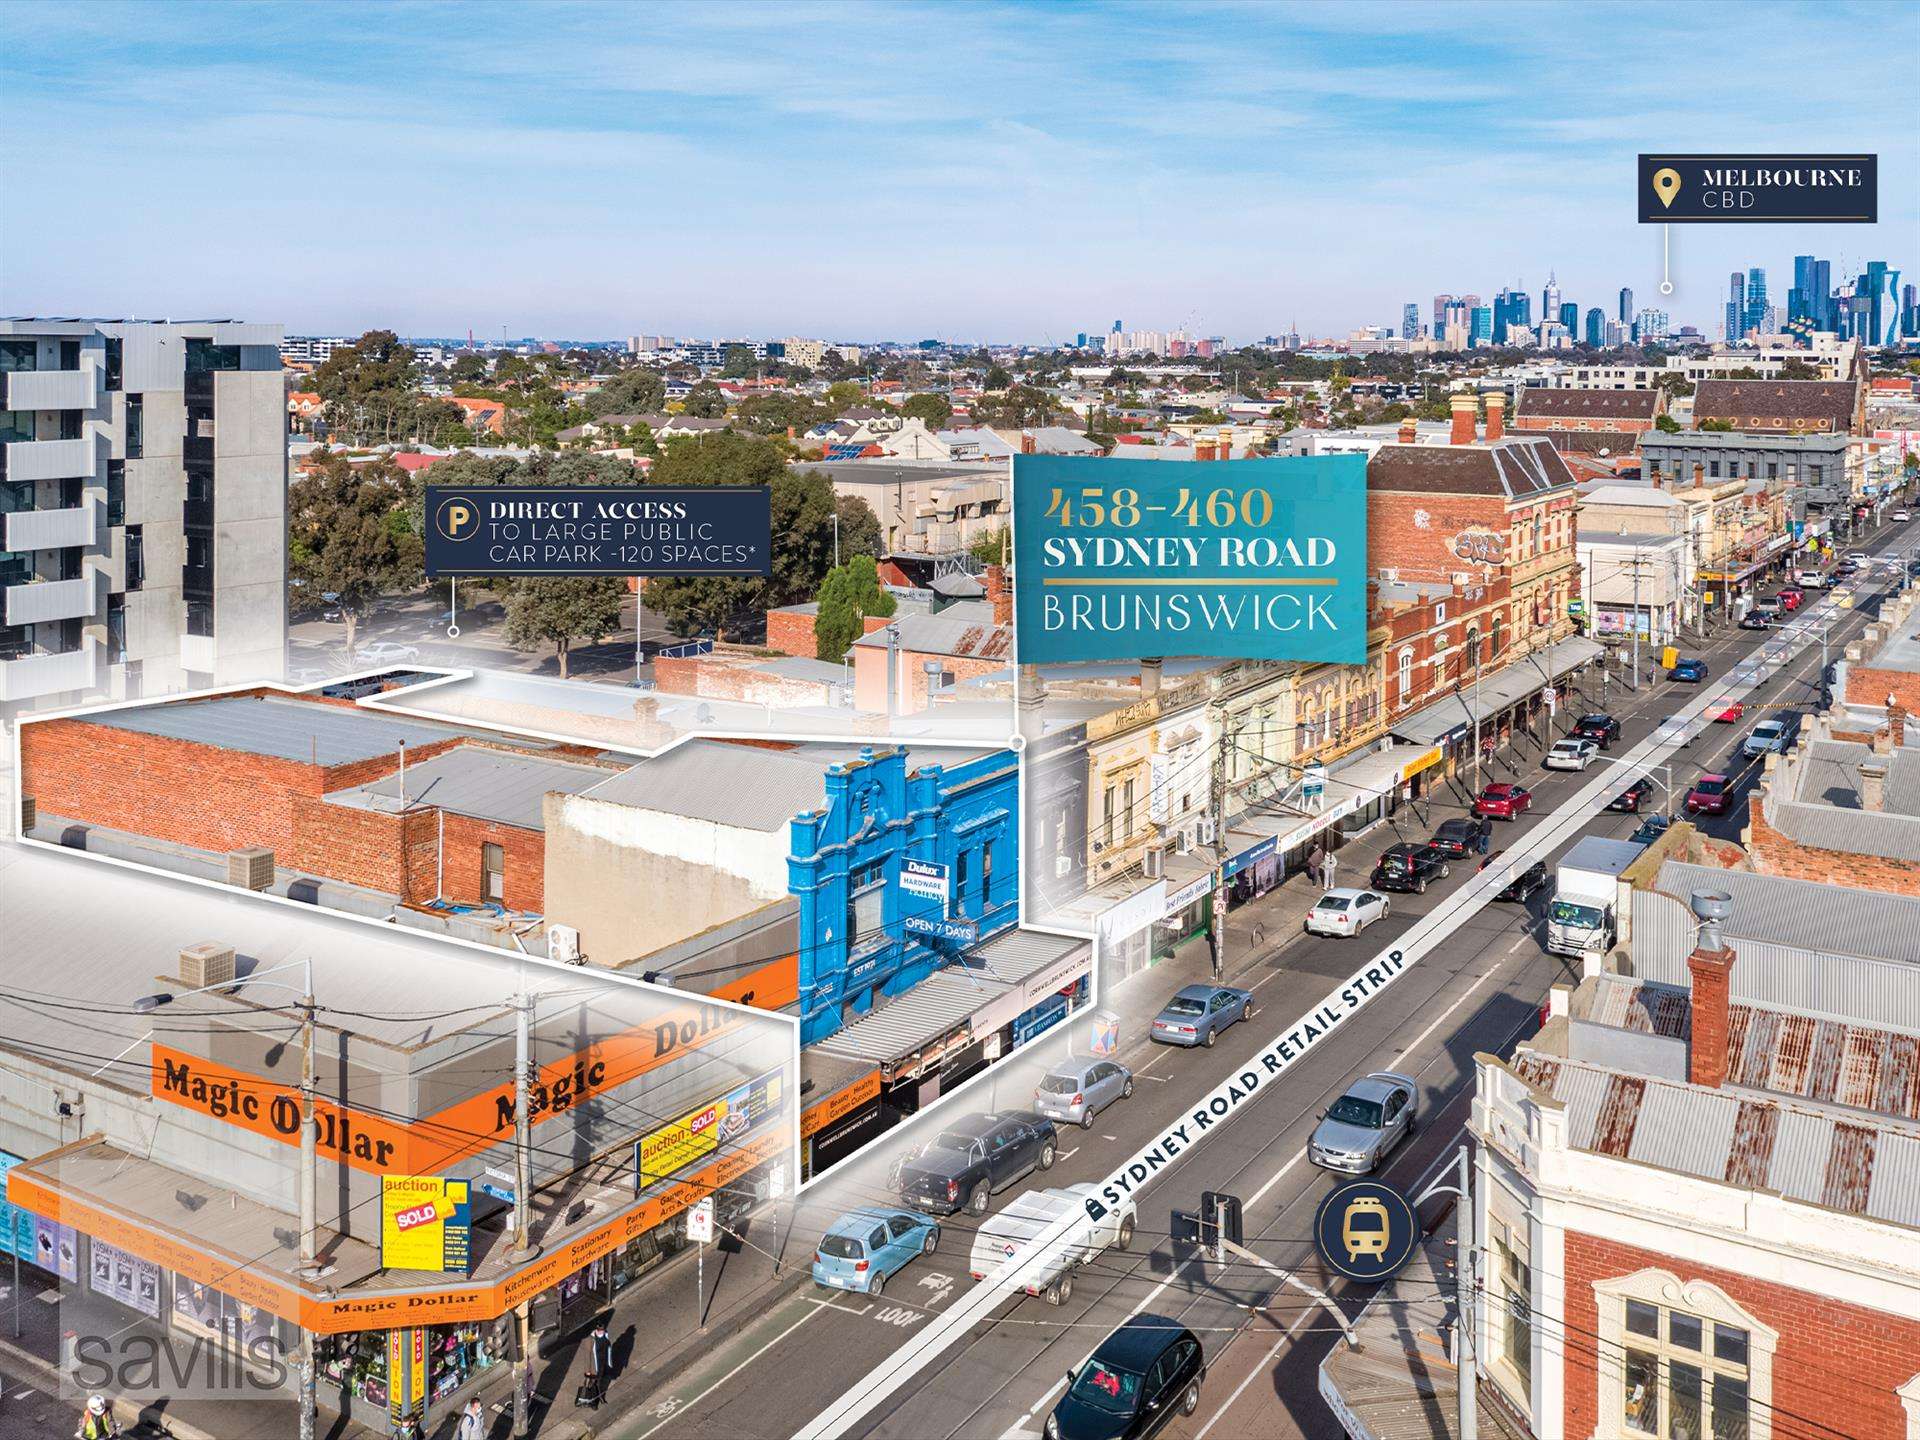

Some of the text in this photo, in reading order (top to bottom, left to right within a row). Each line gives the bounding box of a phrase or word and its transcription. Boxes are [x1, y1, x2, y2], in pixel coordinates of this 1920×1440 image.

[908, 861, 938, 876] Dulux
[903, 877, 942, 890] HARDWARE
[905, 917, 972, 939] OPEN 7 DAYS
[493, 990, 756, 1133] Magic Dollar
[163, 1058, 259, 1118] Magic
[642, 1129, 685, 1160] auction
[691, 1110, 715, 1132] SOLD
[384, 1179, 438, 1192] auction
[659, 1187, 685, 1207] Games
[659, 1202, 677, 1218] Arts
[684, 1185, 706, 1205] Crafts
[397, 1205, 436, 1228] SOLD
[625, 1209, 647, 1227] Party
[625, 1221, 644, 1237] Gifts
[571, 1227, 612, 1256] Stationary
[571, 1240, 610, 1268] Hardware
[504, 1260, 558, 1295] Kitchenware
[504, 1273, 556, 1306] Housewares
[333, 1294, 479, 1314] Magic Dollar
[873, 1306, 926, 1328] LOOK
